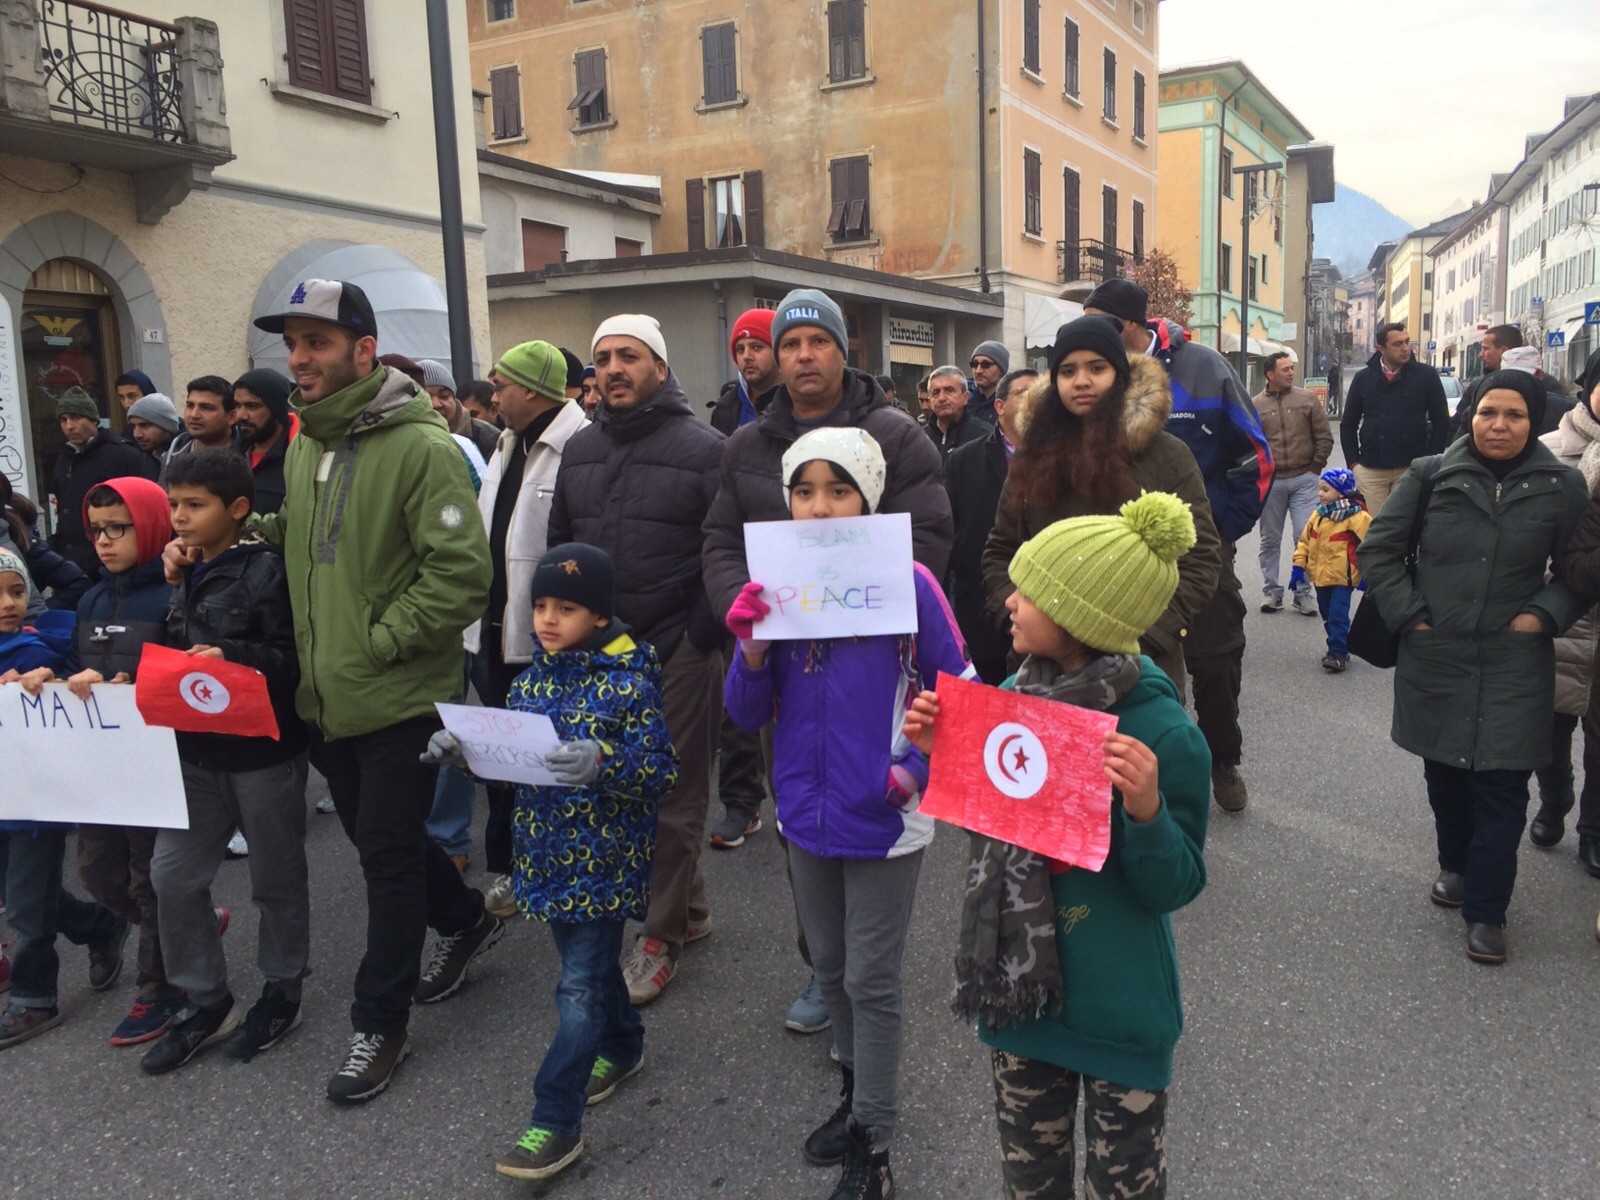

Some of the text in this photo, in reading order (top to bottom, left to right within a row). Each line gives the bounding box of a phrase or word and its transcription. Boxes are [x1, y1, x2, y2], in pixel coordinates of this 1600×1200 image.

[785, 307, 819, 320] ITALIA
[149, 330, 158, 340] 47
[797, 526, 872, 548] ISLAM
[818, 565, 840, 583] IS
[774, 584, 883, 616] PEACE
[464, 710, 524, 737] STOP
